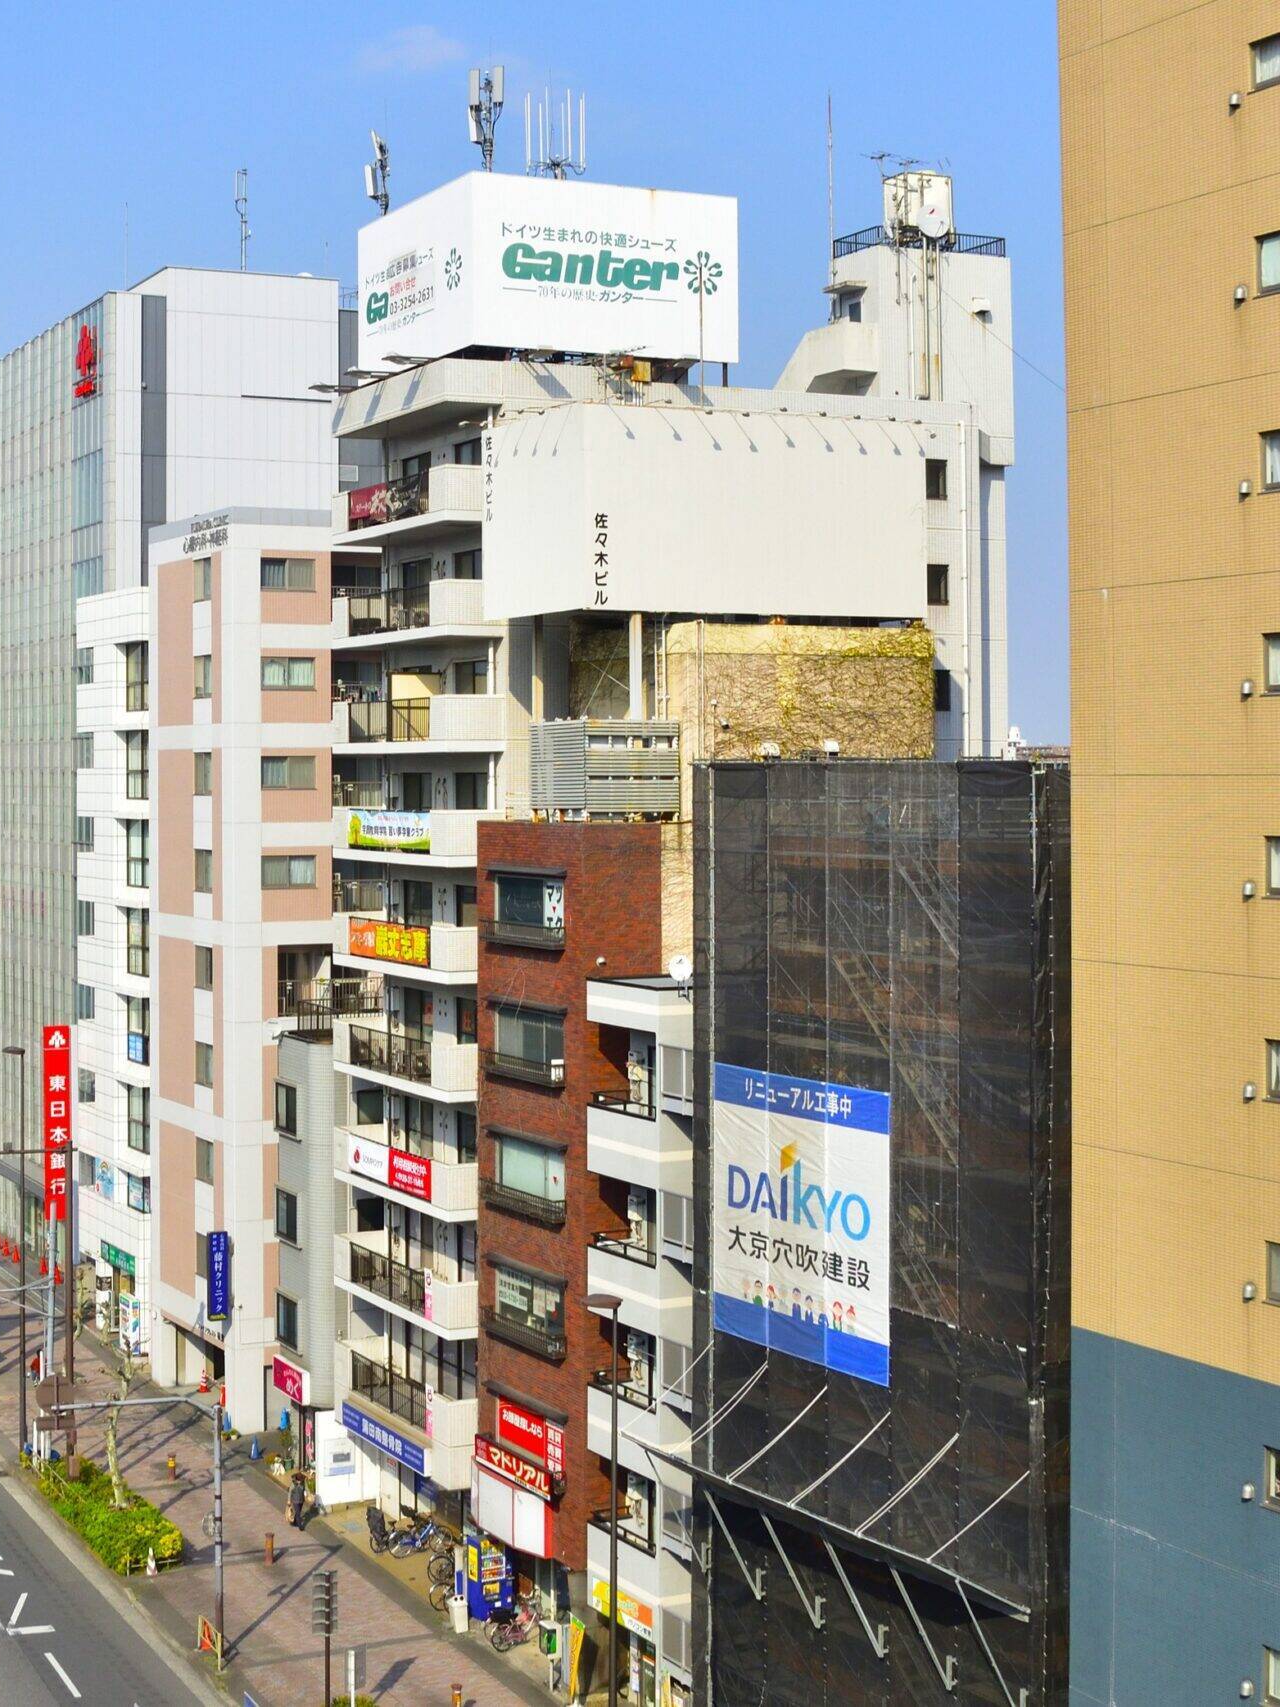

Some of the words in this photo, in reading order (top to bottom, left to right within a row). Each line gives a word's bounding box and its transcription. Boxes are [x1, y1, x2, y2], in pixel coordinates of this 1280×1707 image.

[501, 222, 677, 252] ドイツ生まれの快適シューズ
[502, 242, 680, 291] Ganter
[389, 286, 434, 315] 03-3254-2631
[485, 437, 493, 522] 佐々木ビル
[594, 512, 609, 606] 佐々木ビル
[745, 1077, 851, 1119] リニューアル工事中
[49, 1075, 67, 1195] 東日本銀行
[728, 1225, 871, 1291] 大京穴吹建設
[488, 1446, 549, 1492] マドリアル
